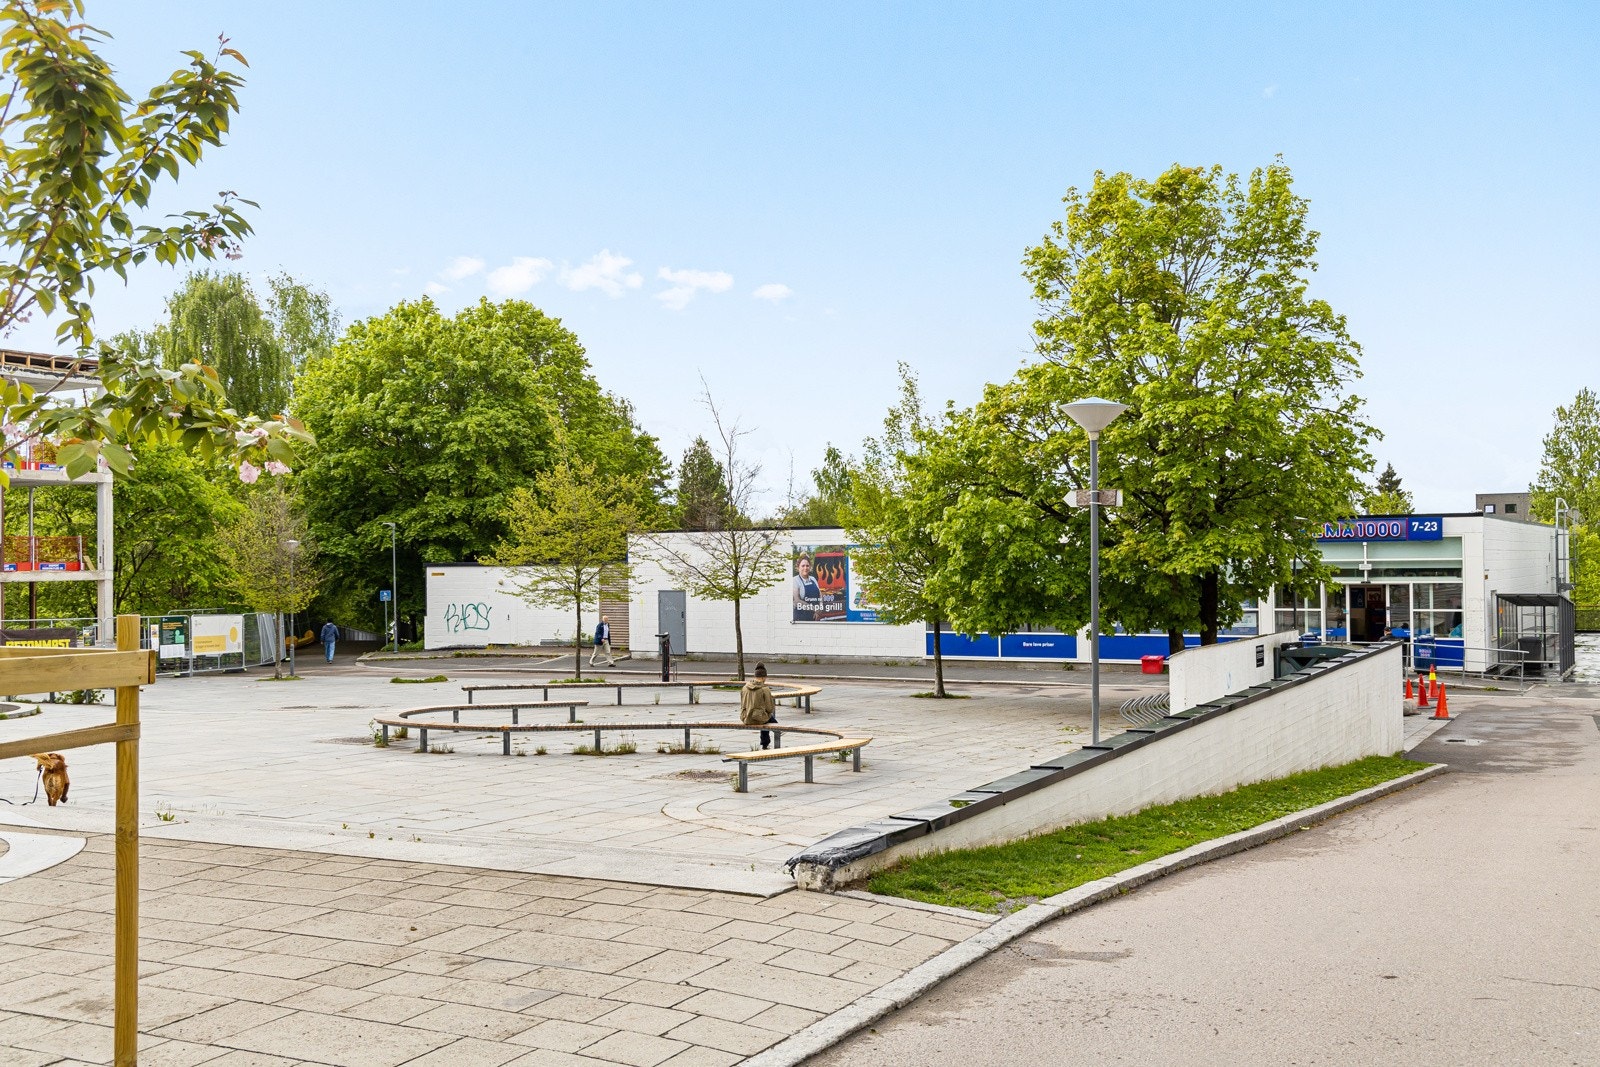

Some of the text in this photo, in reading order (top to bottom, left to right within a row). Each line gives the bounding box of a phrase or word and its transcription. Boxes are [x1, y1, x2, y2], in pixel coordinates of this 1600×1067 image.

[1311, 521, 1401, 538] MA 1000
[1411, 521, 1438, 532] 7-23
[796, 601, 843, 612] Best på grill!
